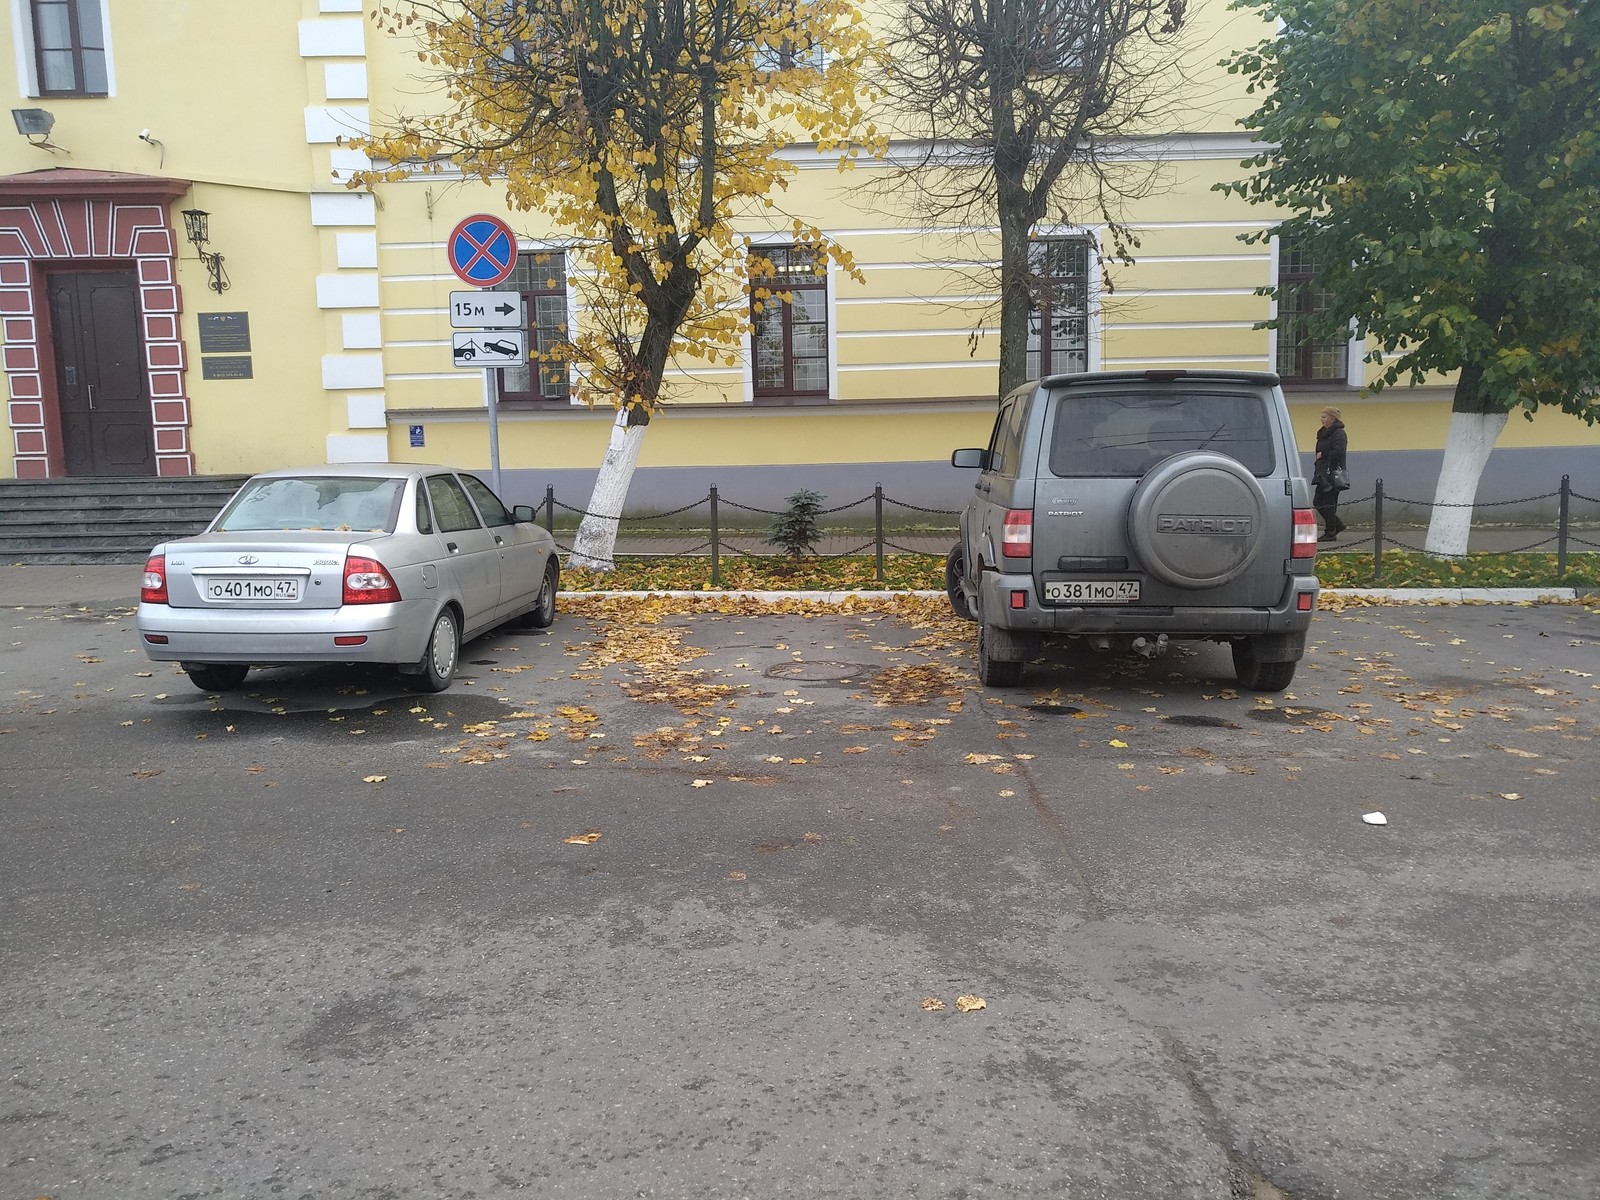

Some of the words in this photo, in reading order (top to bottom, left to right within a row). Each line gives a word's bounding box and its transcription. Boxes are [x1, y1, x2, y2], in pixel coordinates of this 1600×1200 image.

[1160, 518, 1250, 533] PATRIOT
[276, 581, 292, 593] 47
[1119, 583, 1134, 594] 47
